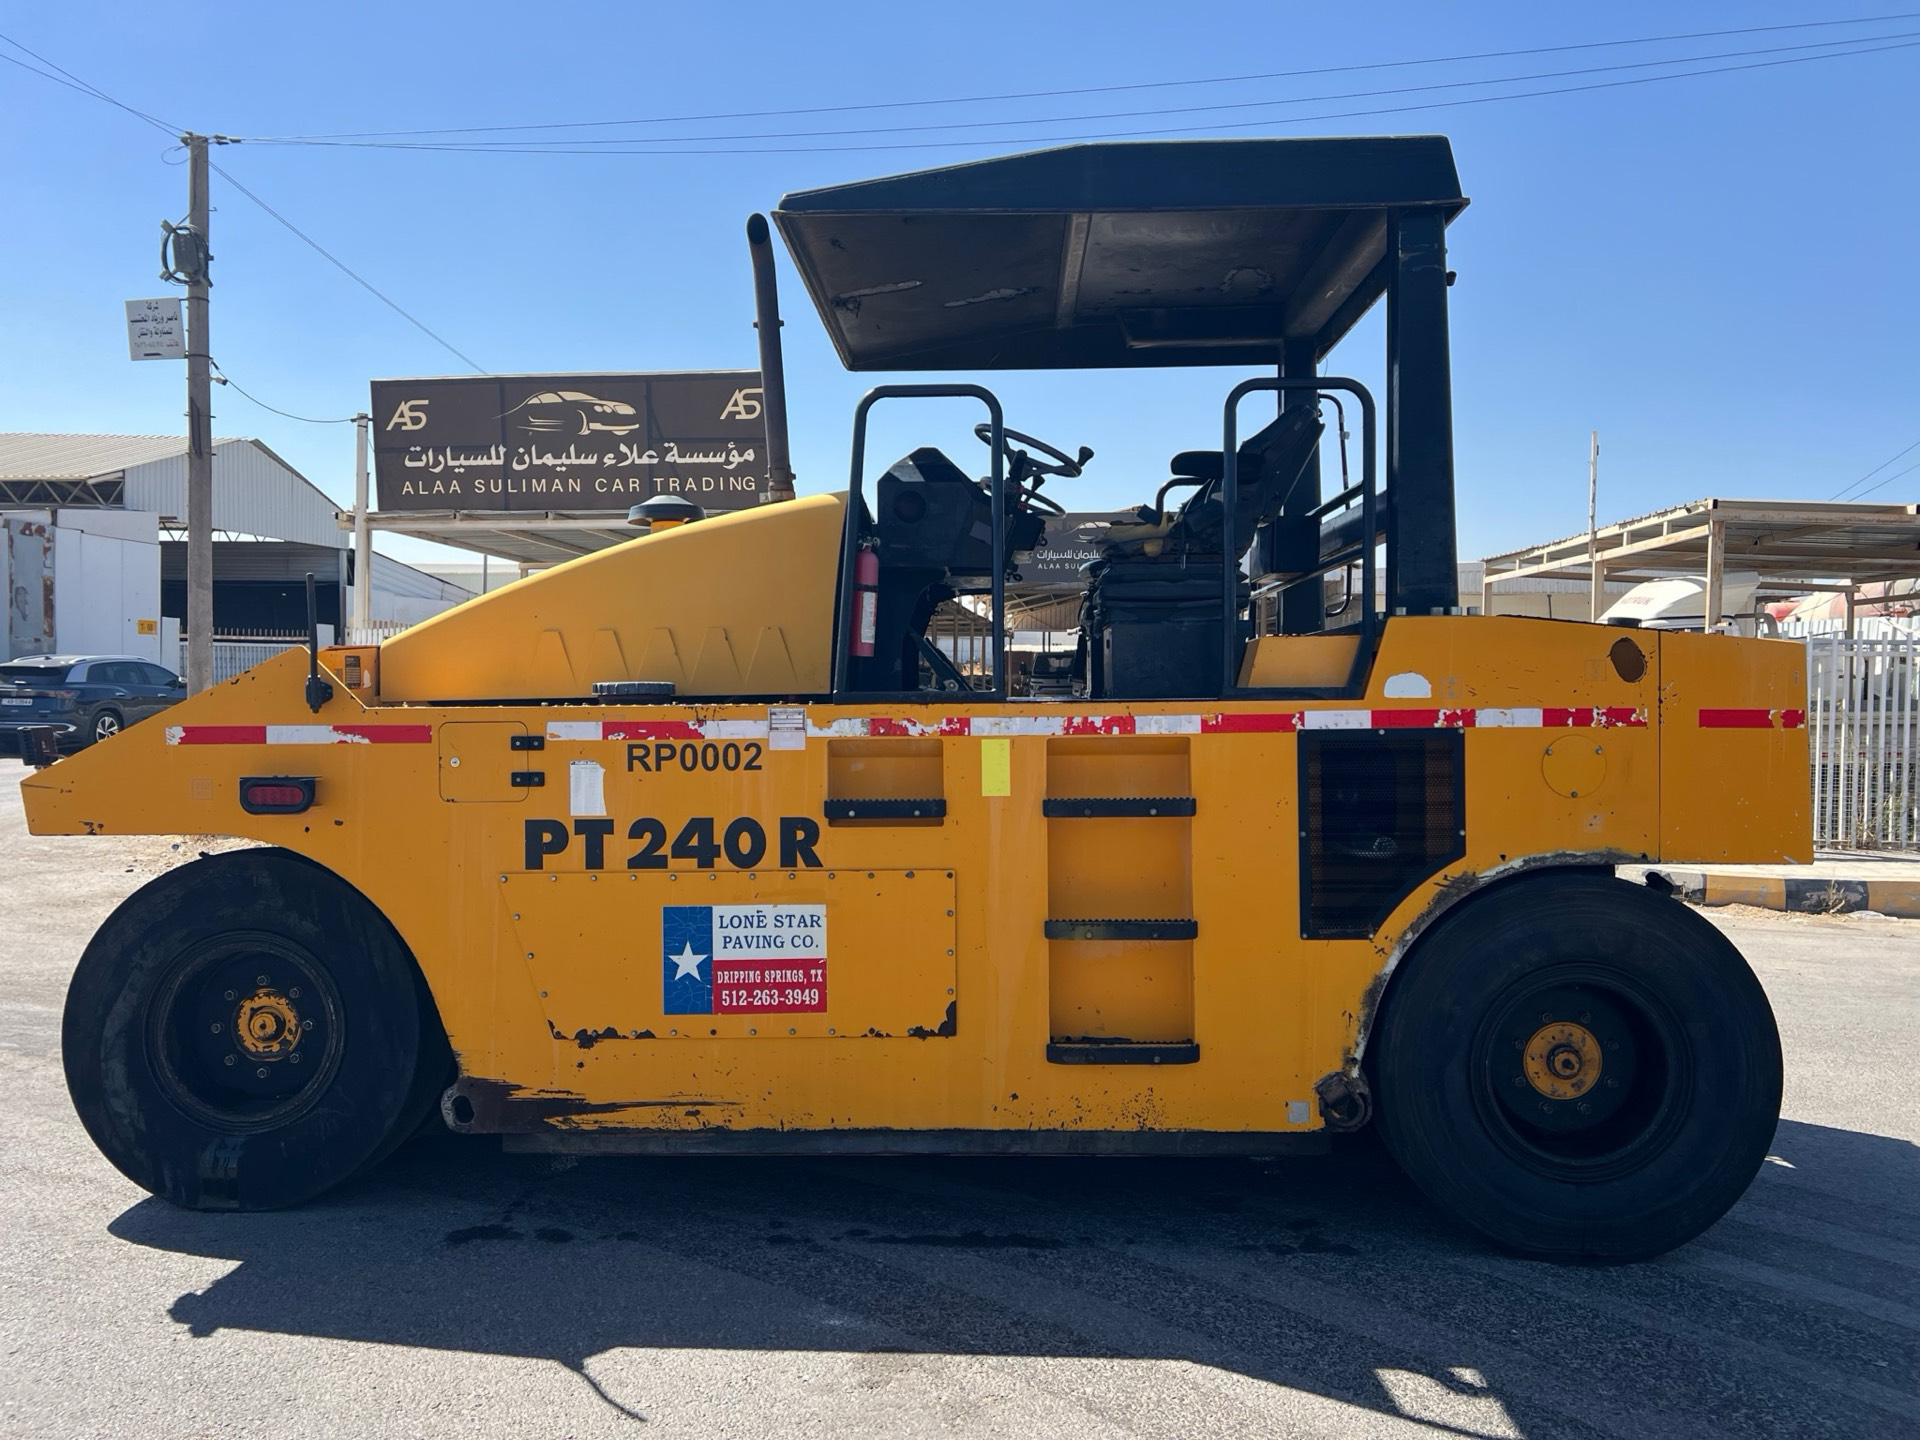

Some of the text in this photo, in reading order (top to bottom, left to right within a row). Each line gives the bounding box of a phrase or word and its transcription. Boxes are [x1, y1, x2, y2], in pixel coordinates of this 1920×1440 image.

[404, 441, 756, 473] مؤسسة علاء سليمان للسيارات
[402, 476, 756, 495] ALAA SULIMAN CAR TRADING
[1037, 562, 1061, 570] ALAA
[626, 742, 763, 773] RP0002
[718, 914, 822, 929] LONE STAR
[722, 934, 819, 949] PAVING CO.
[717, 969, 823, 985] DRIPPING SPRINGS, TX
[721, 988, 819, 1006] 512-263-3949
